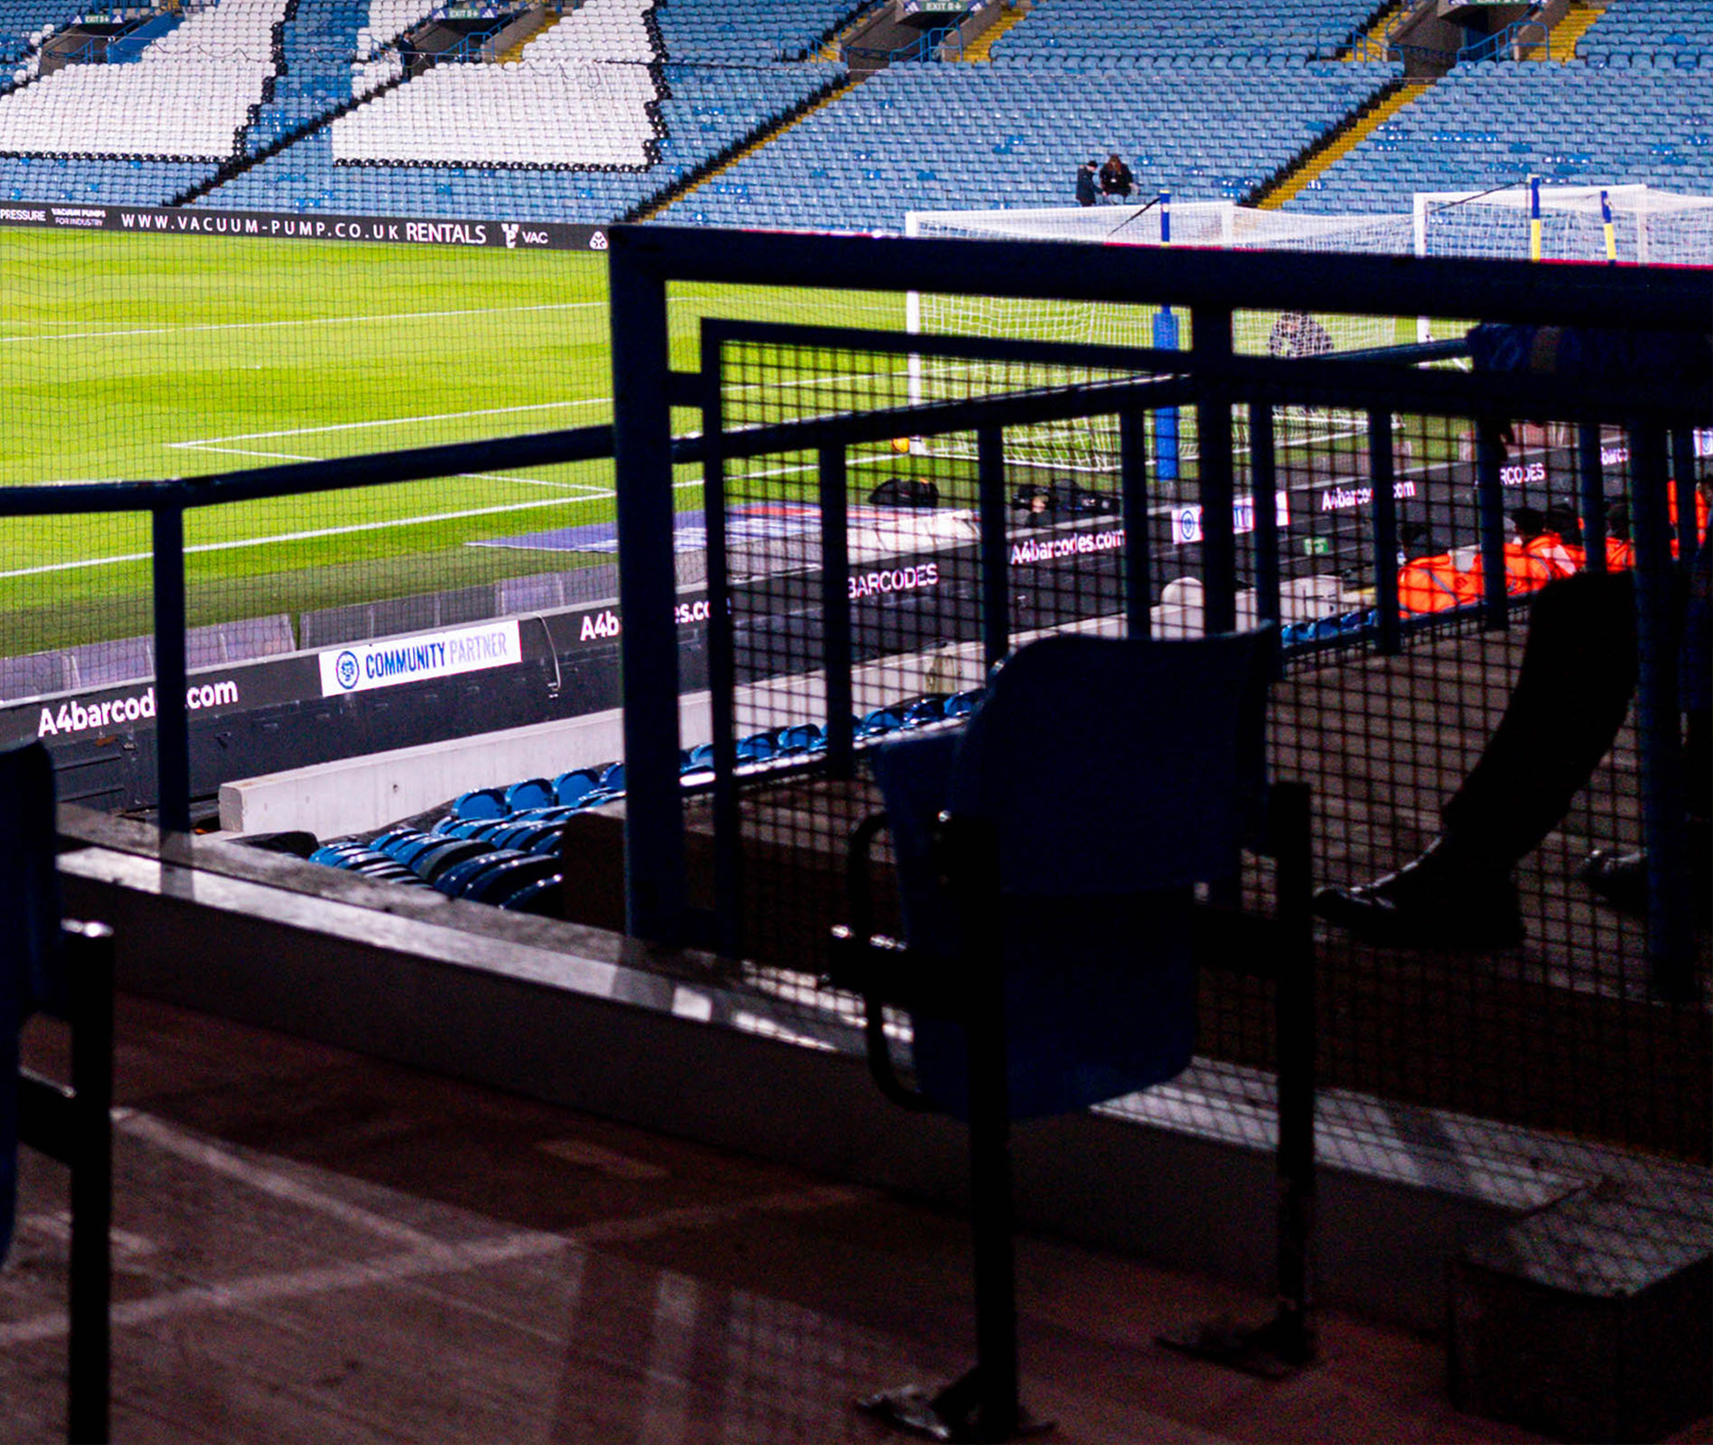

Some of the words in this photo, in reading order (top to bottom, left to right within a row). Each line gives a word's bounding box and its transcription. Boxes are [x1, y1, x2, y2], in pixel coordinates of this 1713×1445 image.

[0, 209, 46, 222] PRESSURE
[121, 213, 399, 240] WWW.VACUUM-PUMP.CO.UK
[405, 222, 487, 245] RENTALS
[521, 230, 549, 244] VAC
[1499, 461, 1546, 486] RCODES
[365, 641, 445, 680] COMMUNITY
[449, 631, 507, 665] PARTNER
[37, 680, 239, 738] A4barcodcom
